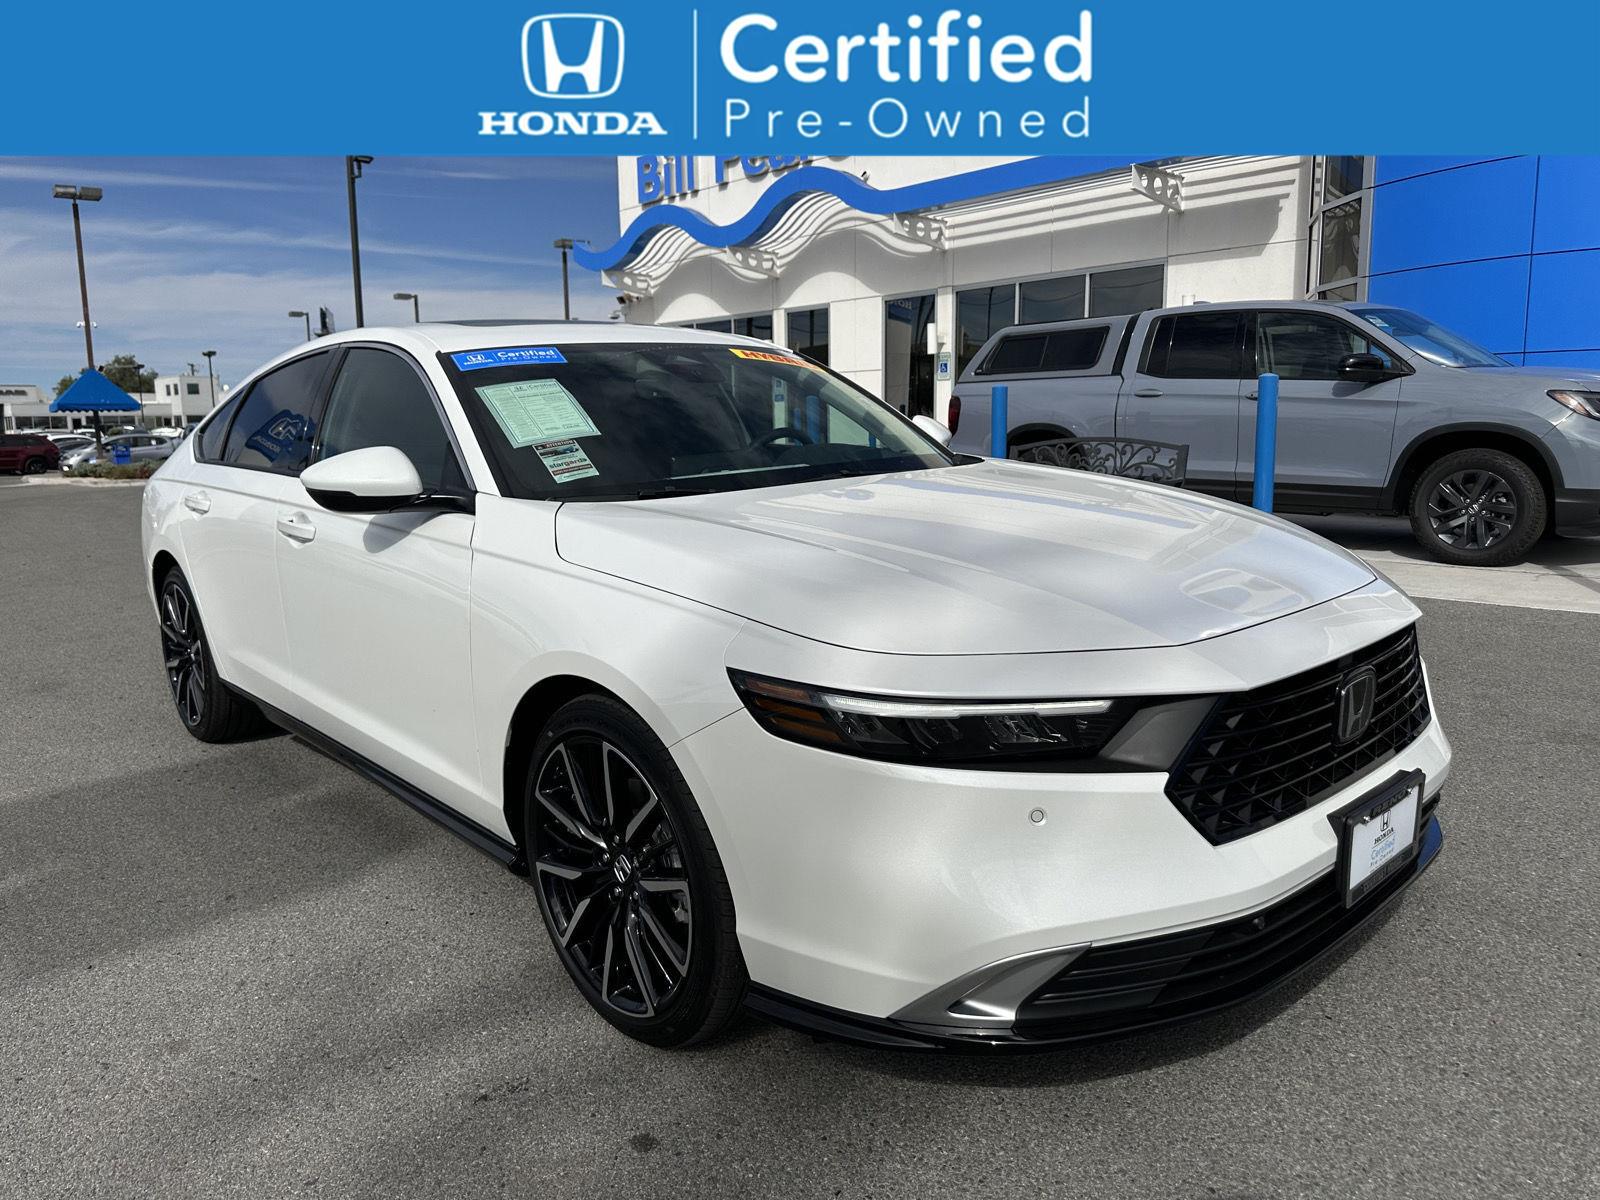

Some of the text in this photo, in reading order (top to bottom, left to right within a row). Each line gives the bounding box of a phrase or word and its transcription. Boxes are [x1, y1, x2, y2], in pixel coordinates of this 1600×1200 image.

[637, 156, 699, 204] Bill
[498, 350, 554, 358] Certified
[1374, 827, 1394, 845] HONDA
